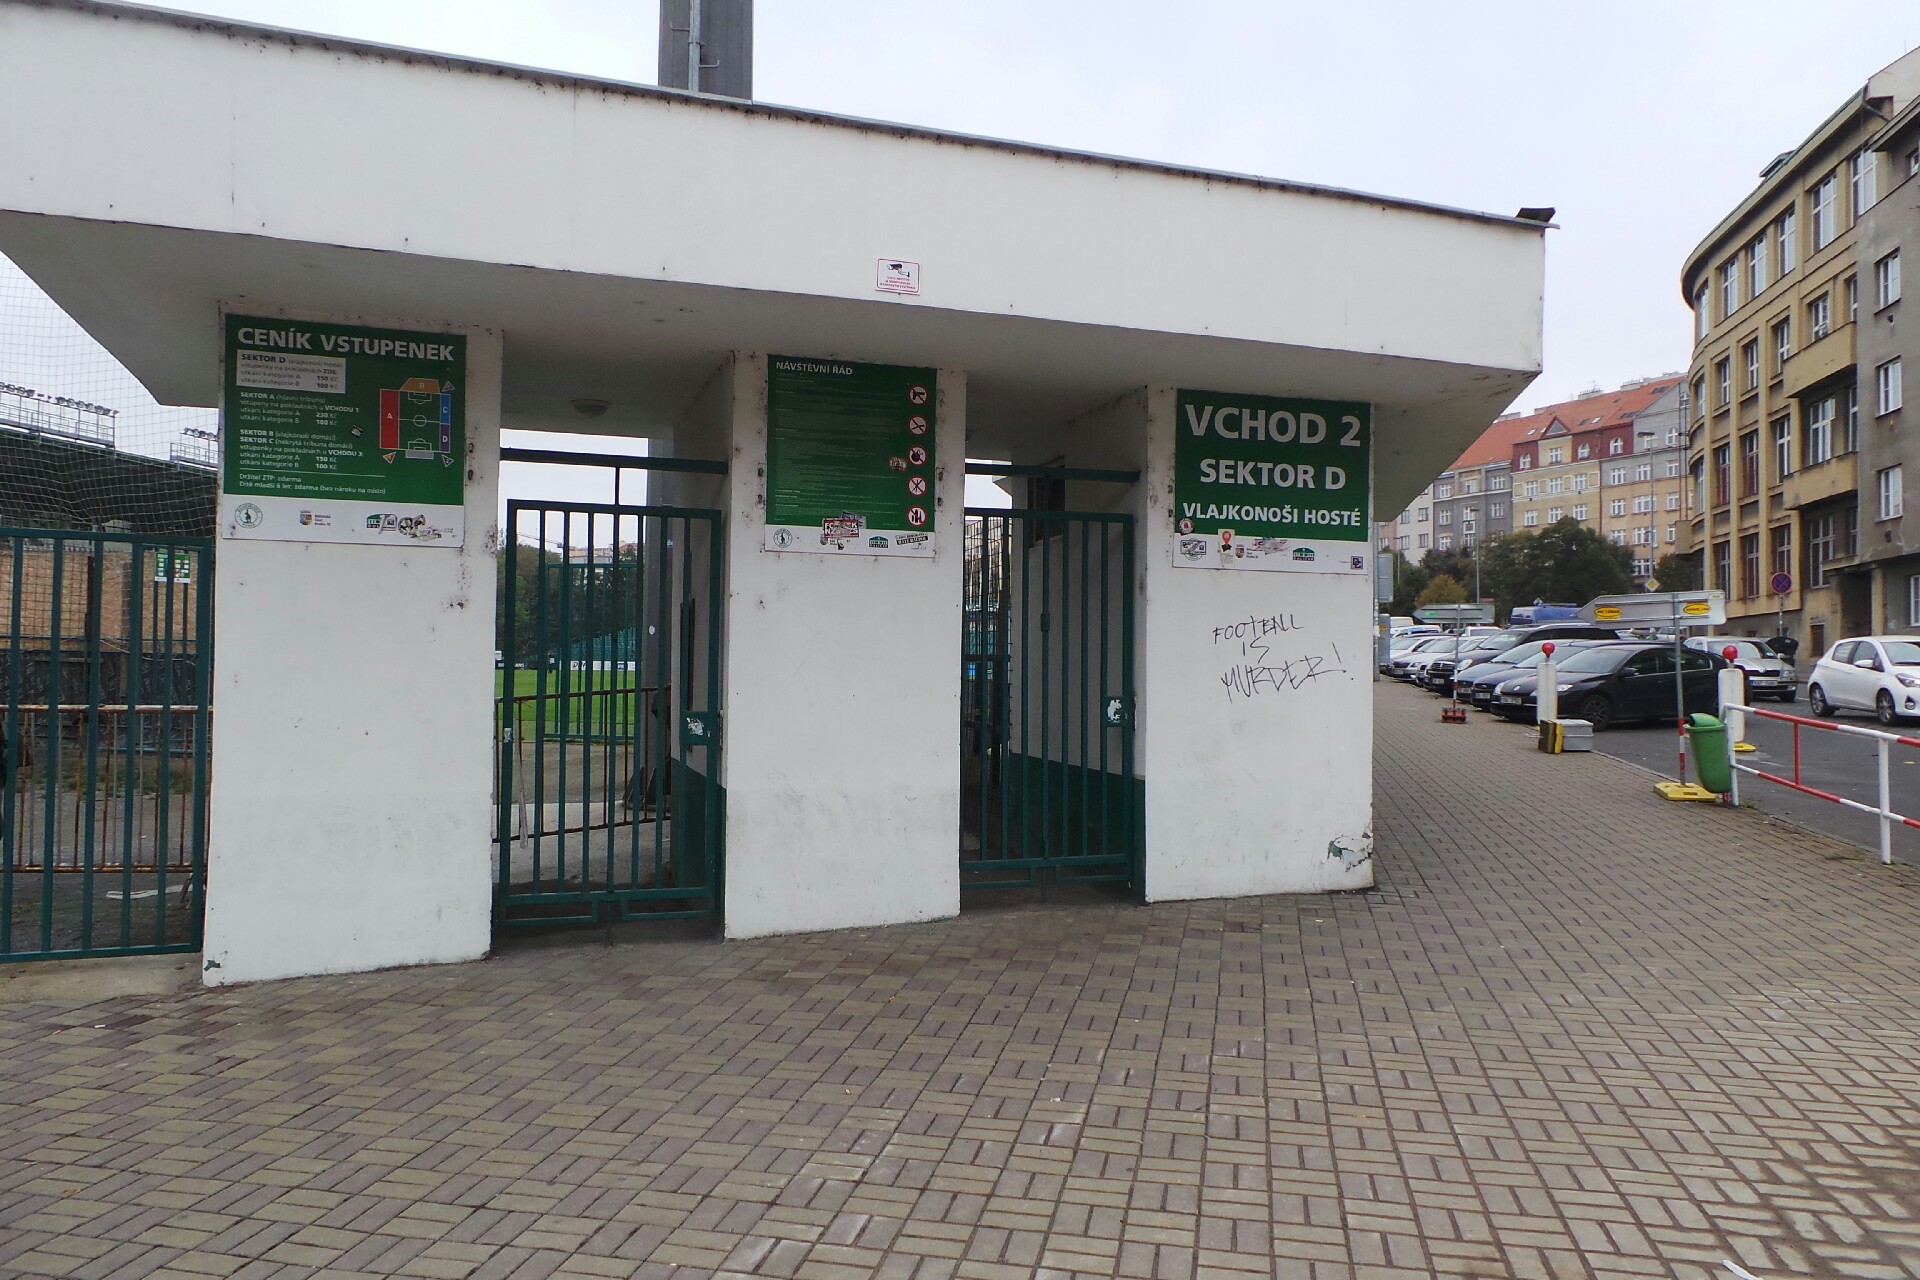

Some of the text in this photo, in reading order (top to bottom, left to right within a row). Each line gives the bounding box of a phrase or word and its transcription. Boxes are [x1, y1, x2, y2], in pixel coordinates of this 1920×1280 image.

[238, 327, 454, 361] CENÍK VSTUPENEK
[241, 353, 276, 362] SEKTOR
[832, 364, 853, 375] ŘÁD
[240, 391, 268, 399] SEKTOR
[325, 404, 354, 413] VCHODU
[442, 406, 449, 414] C
[1185, 404, 1361, 447] VCHOD 2
[240, 428, 268, 436] SEKTOR
[240, 436, 268, 444] SEKTOR
[442, 435, 448, 443] D
[328, 449, 357, 457] VCHODU
[1200, 458, 1346, 490] SEKTOR D
[1182, 502, 1361, 526] VLAJKONOŠI HOSTÉ
[1242, 637, 1269, 664] IS
